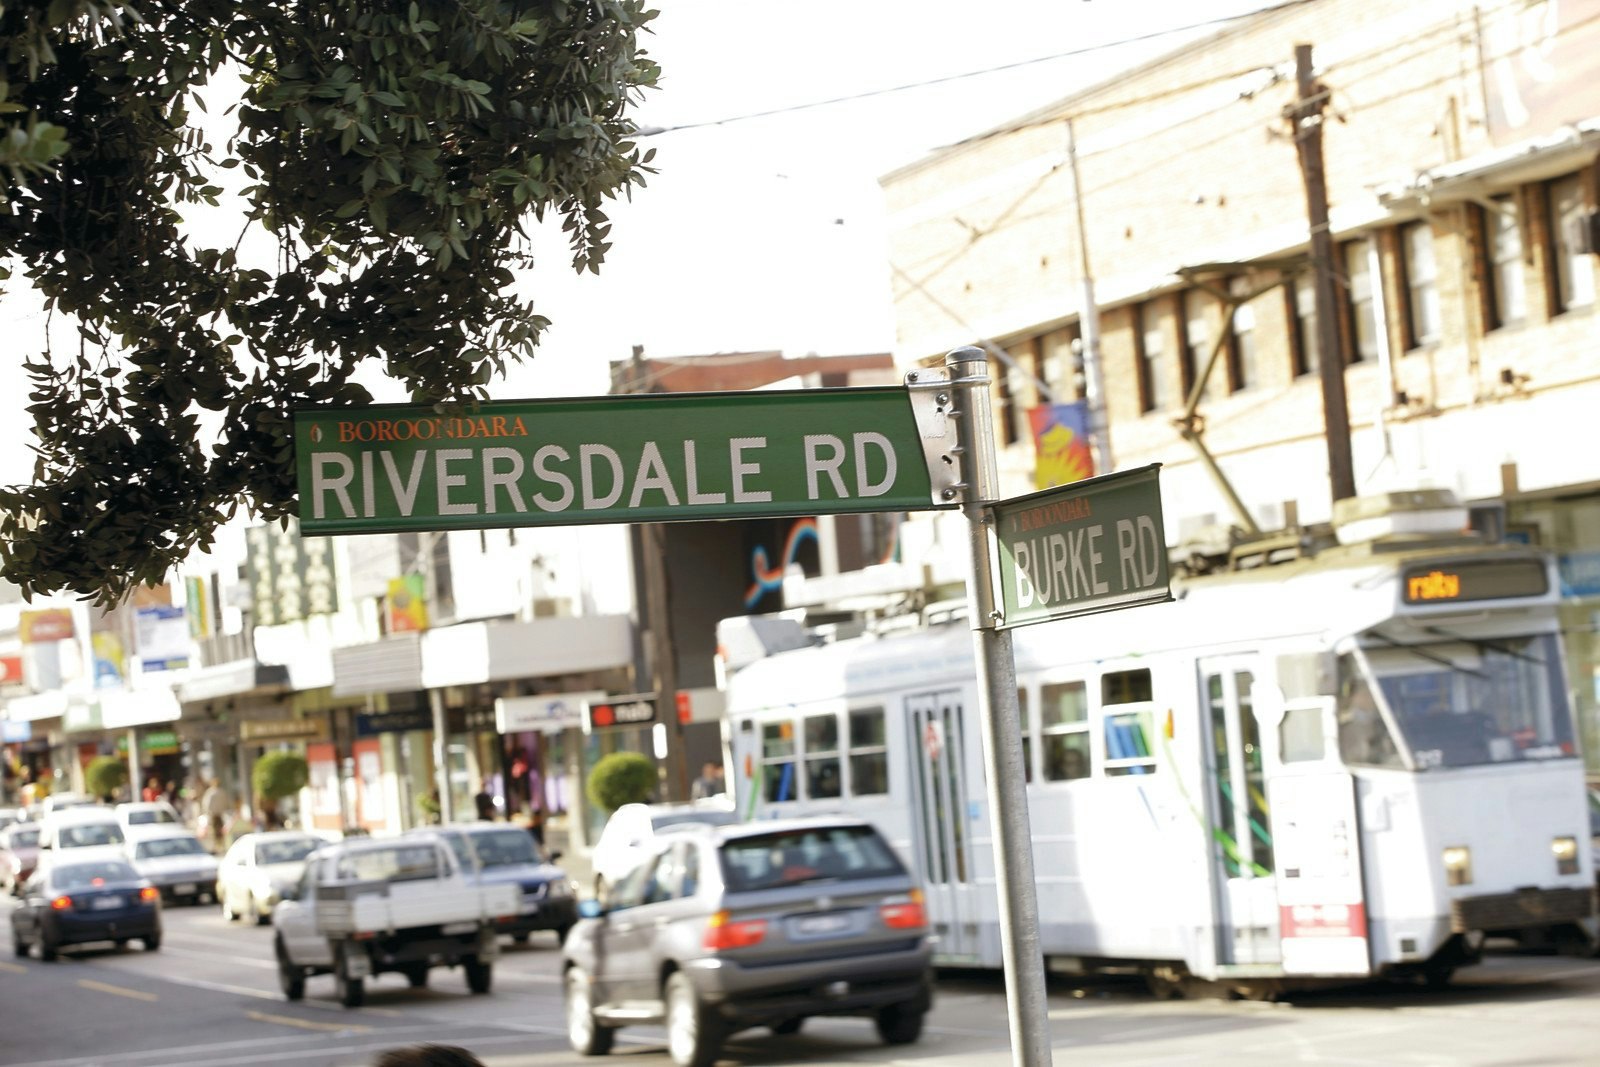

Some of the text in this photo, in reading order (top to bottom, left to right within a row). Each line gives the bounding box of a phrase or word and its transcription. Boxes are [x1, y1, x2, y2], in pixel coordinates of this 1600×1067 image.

[311, 431, 897, 519] RIVERSDALE RD
[1013, 515, 1159, 609] BURKE RD
